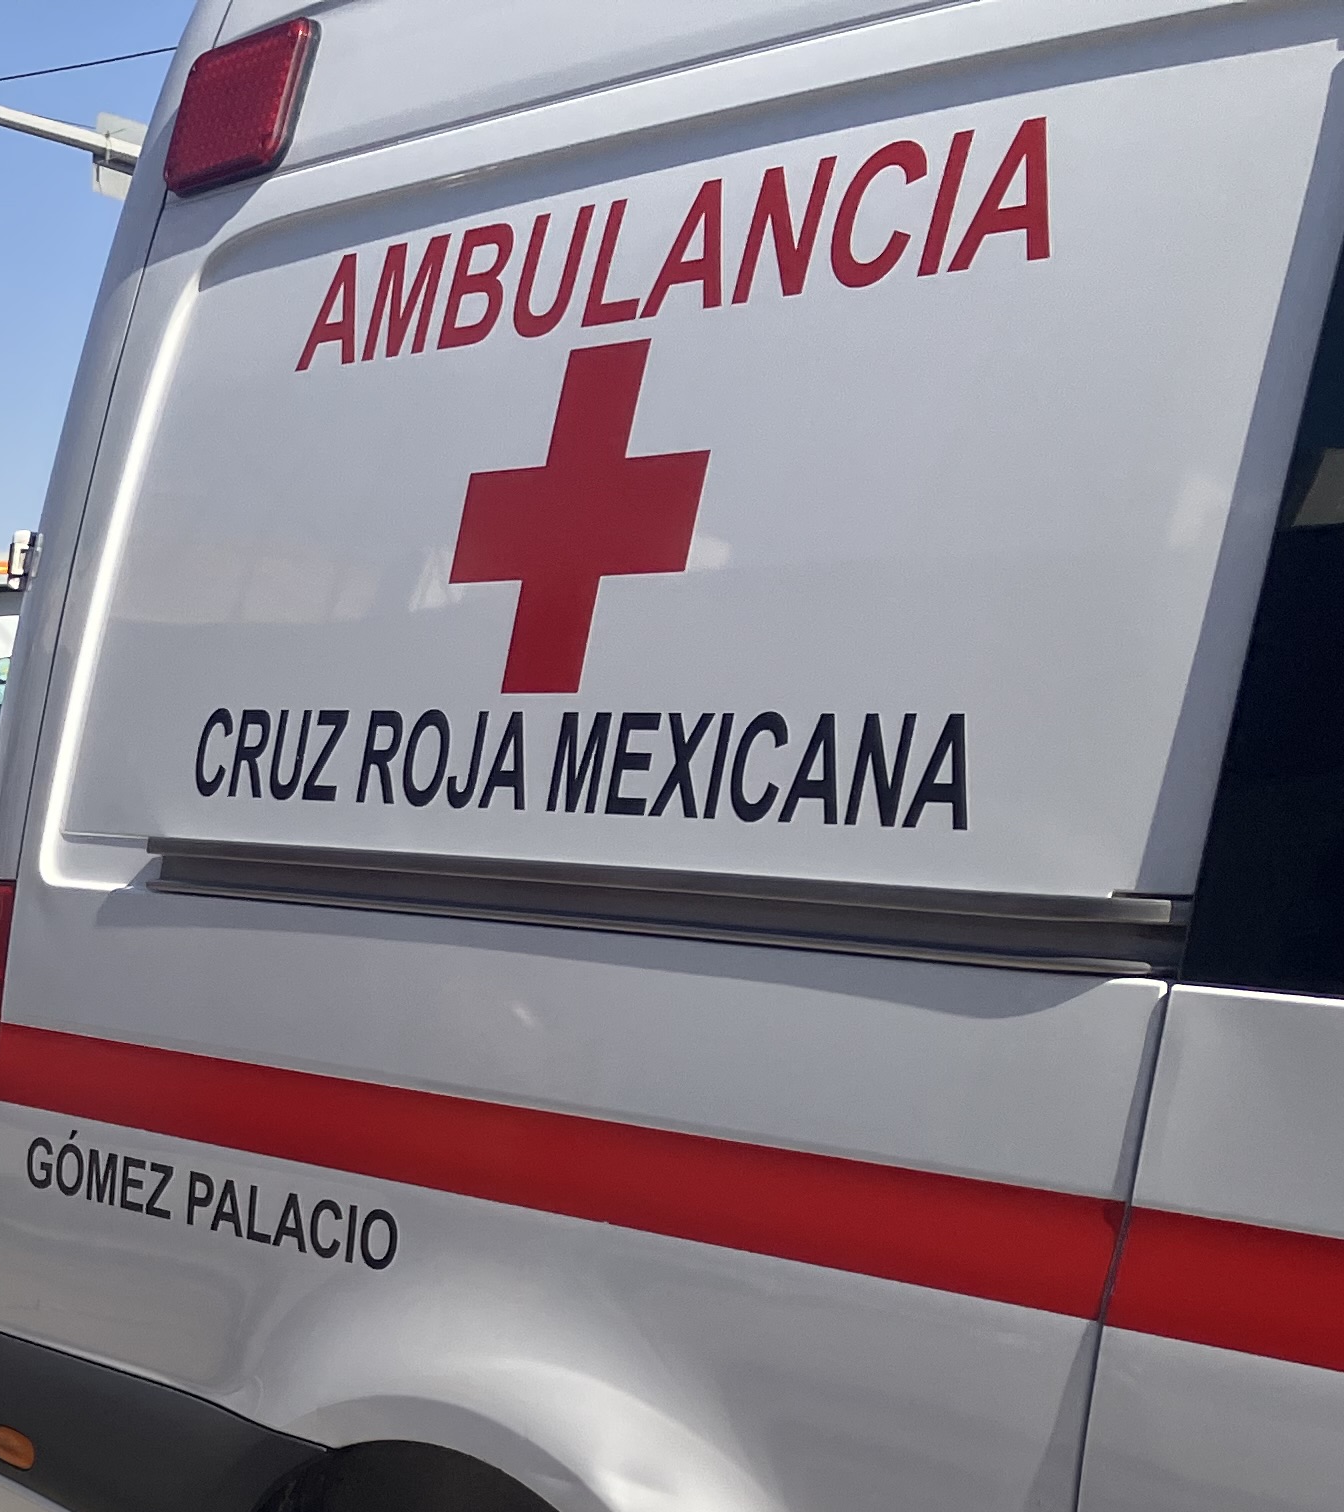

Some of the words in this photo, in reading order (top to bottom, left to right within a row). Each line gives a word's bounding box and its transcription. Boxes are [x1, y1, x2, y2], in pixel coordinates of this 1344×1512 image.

[294, 116, 1051, 372] AMBULANCIA
[192, 706, 350, 802] CRUZ
[356, 709, 528, 812] ROJA
[546, 711, 969, 831] MEXICANA
[25, 1129, 176, 1220] GÓMEZ
[186, 1170, 399, 1271] PALACIO
